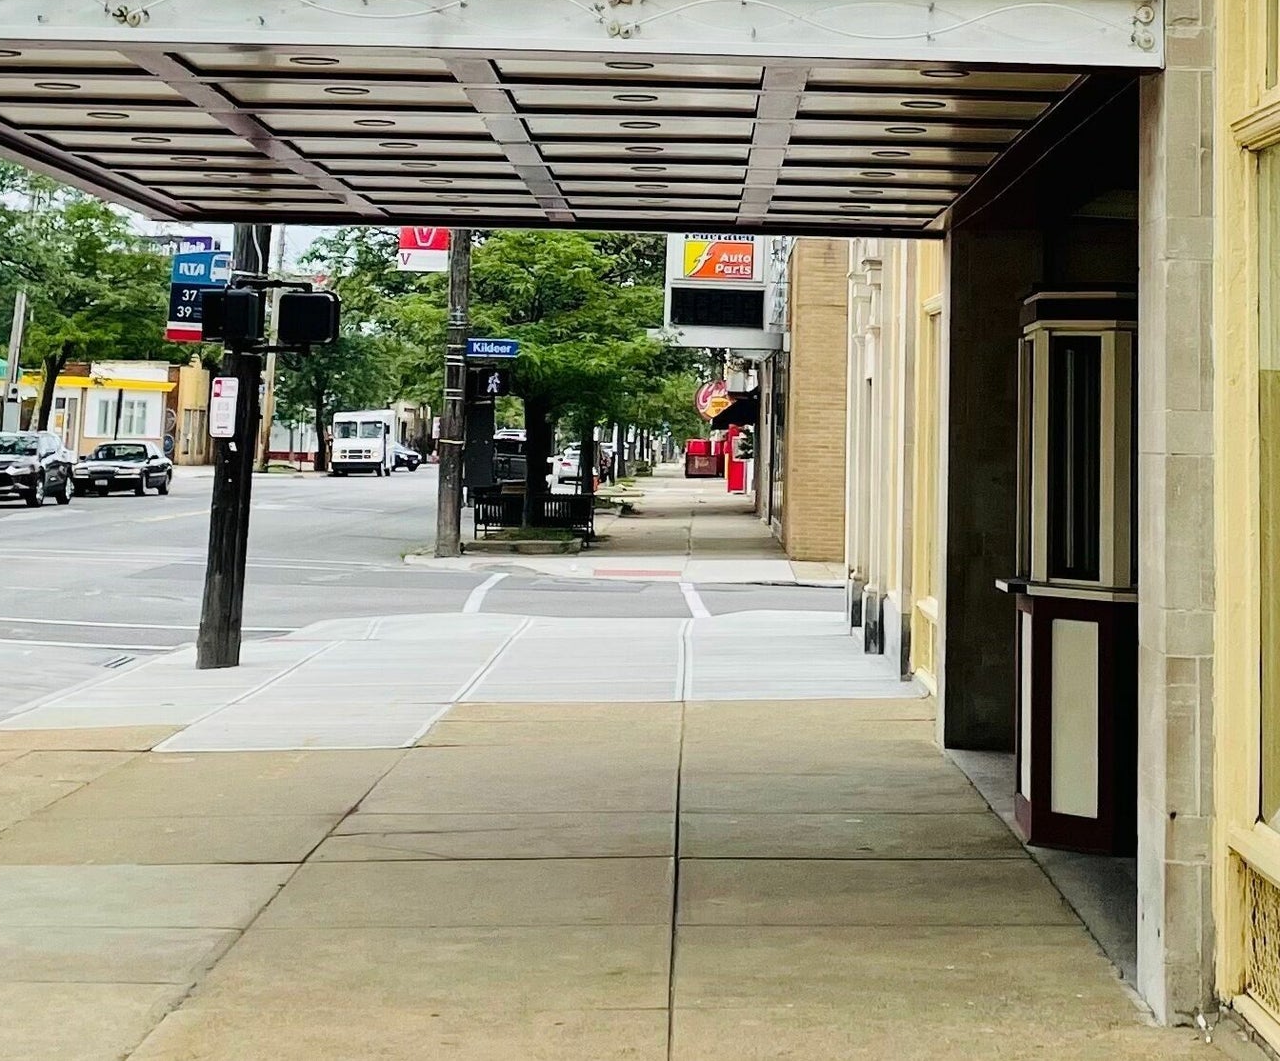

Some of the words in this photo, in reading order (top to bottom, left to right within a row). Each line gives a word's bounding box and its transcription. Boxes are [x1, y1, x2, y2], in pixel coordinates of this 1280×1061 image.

[720, 252, 752, 264] Auto
[178, 261, 205, 276] RTA
[714, 263, 752, 275] Parts
[181, 289, 198, 302] 37
[176, 305, 193, 318] 39
[472, 341, 512, 354] Kildeer
